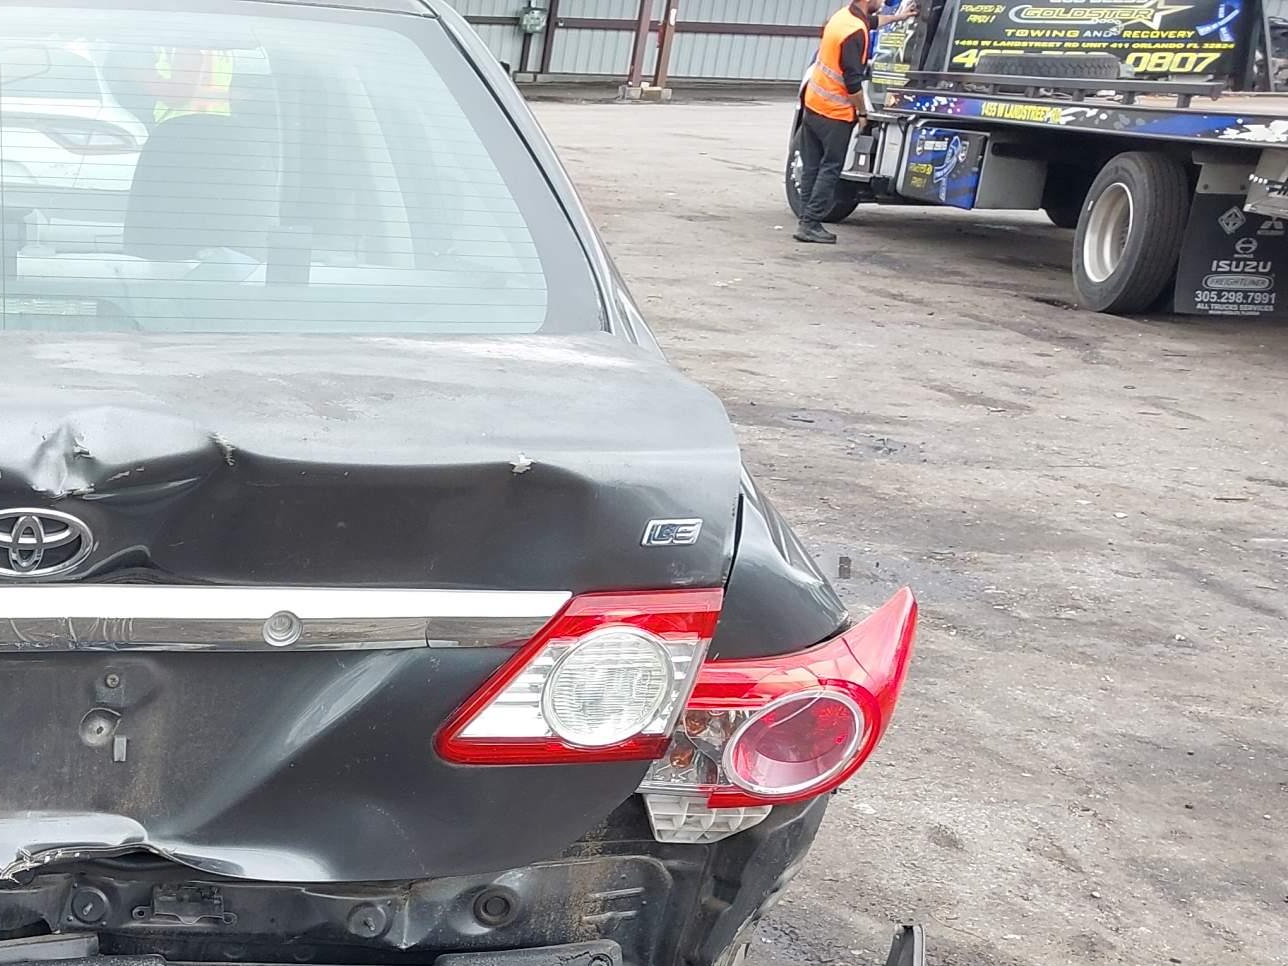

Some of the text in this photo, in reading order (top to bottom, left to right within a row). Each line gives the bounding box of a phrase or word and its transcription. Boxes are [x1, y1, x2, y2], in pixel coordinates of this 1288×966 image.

[1004, 29, 1195, 39] TOWING AND RECOVERY
[993, 40, 1063, 48] LANDSTREET
[1211, 260, 1272, 272] ISUZU
[1194, 290, 1276, 304] 305.298.7991
[642, 519, 701, 545] LE
